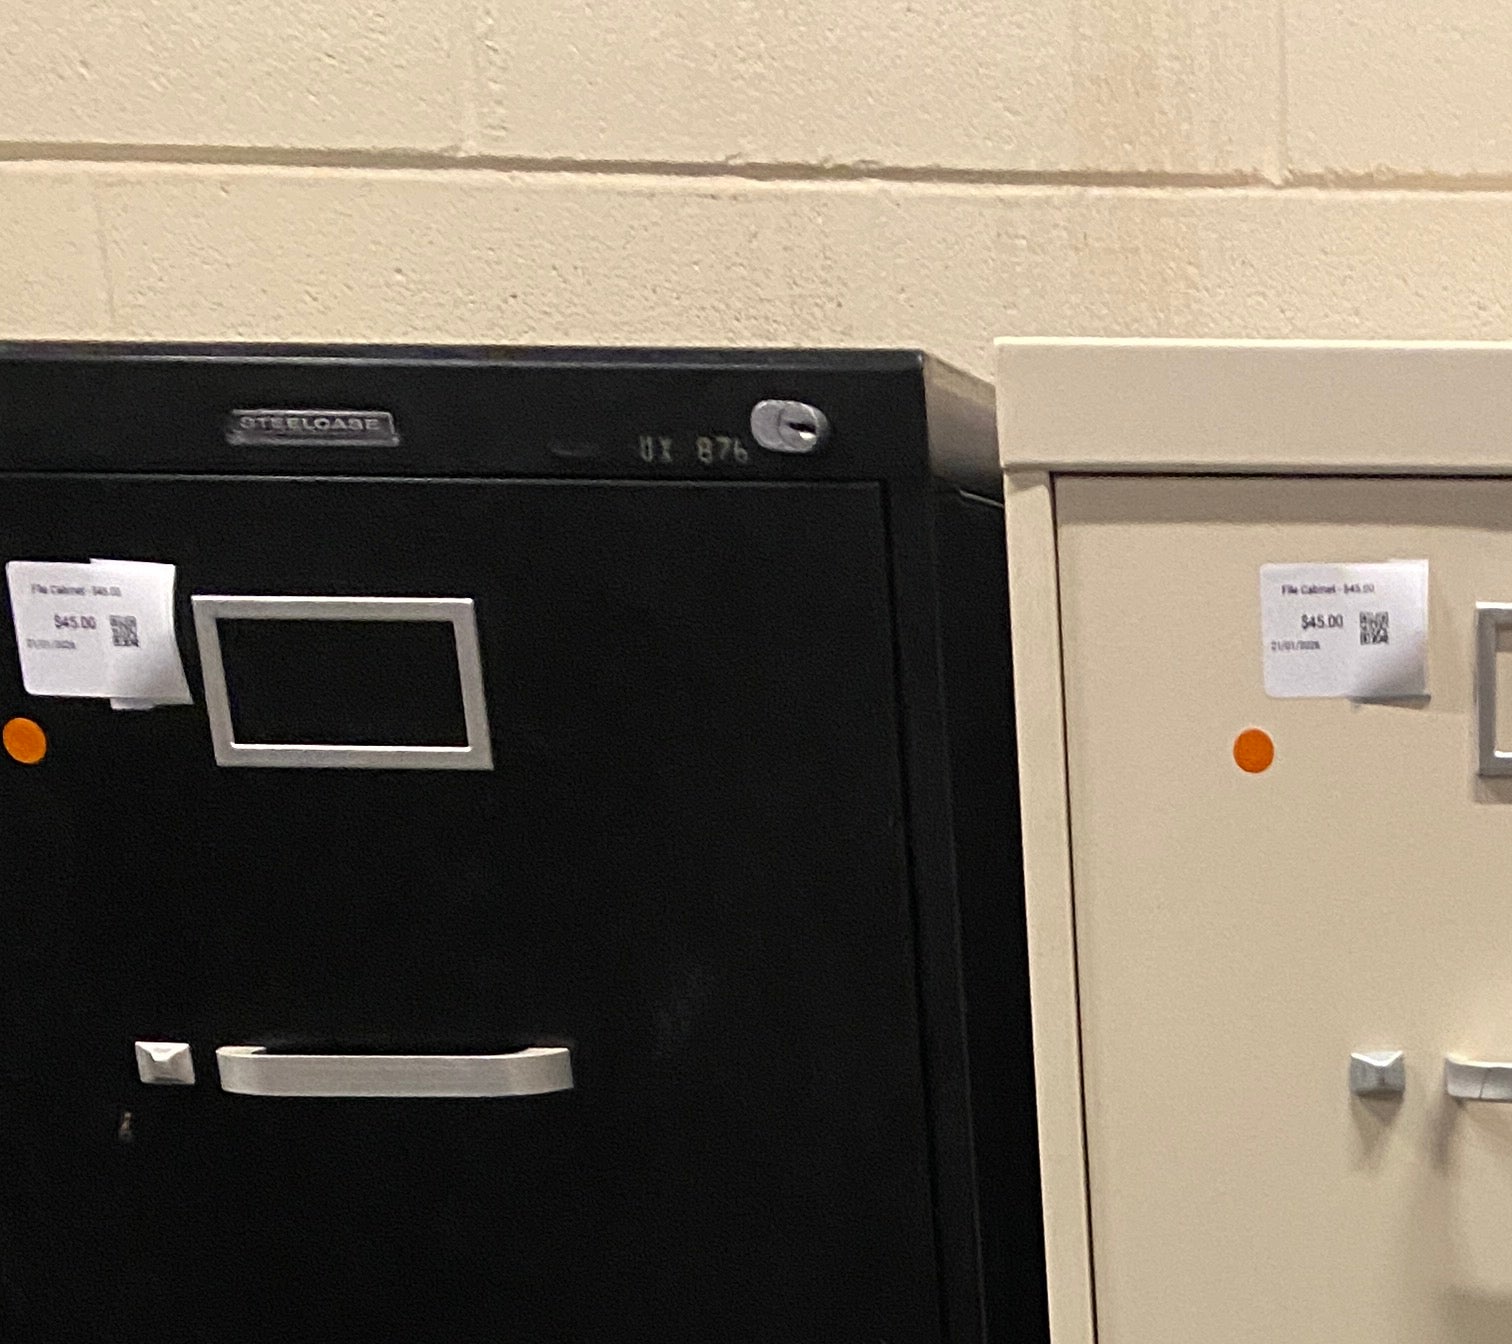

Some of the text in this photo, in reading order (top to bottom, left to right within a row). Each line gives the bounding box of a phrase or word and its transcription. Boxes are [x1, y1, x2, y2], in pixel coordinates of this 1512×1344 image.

[238, 415, 381, 431] STEELCASE
[696, 436, 749, 464] 876
[54, 614, 96, 630] $45.00
[1301, 614, 1344, 631] $45.00
